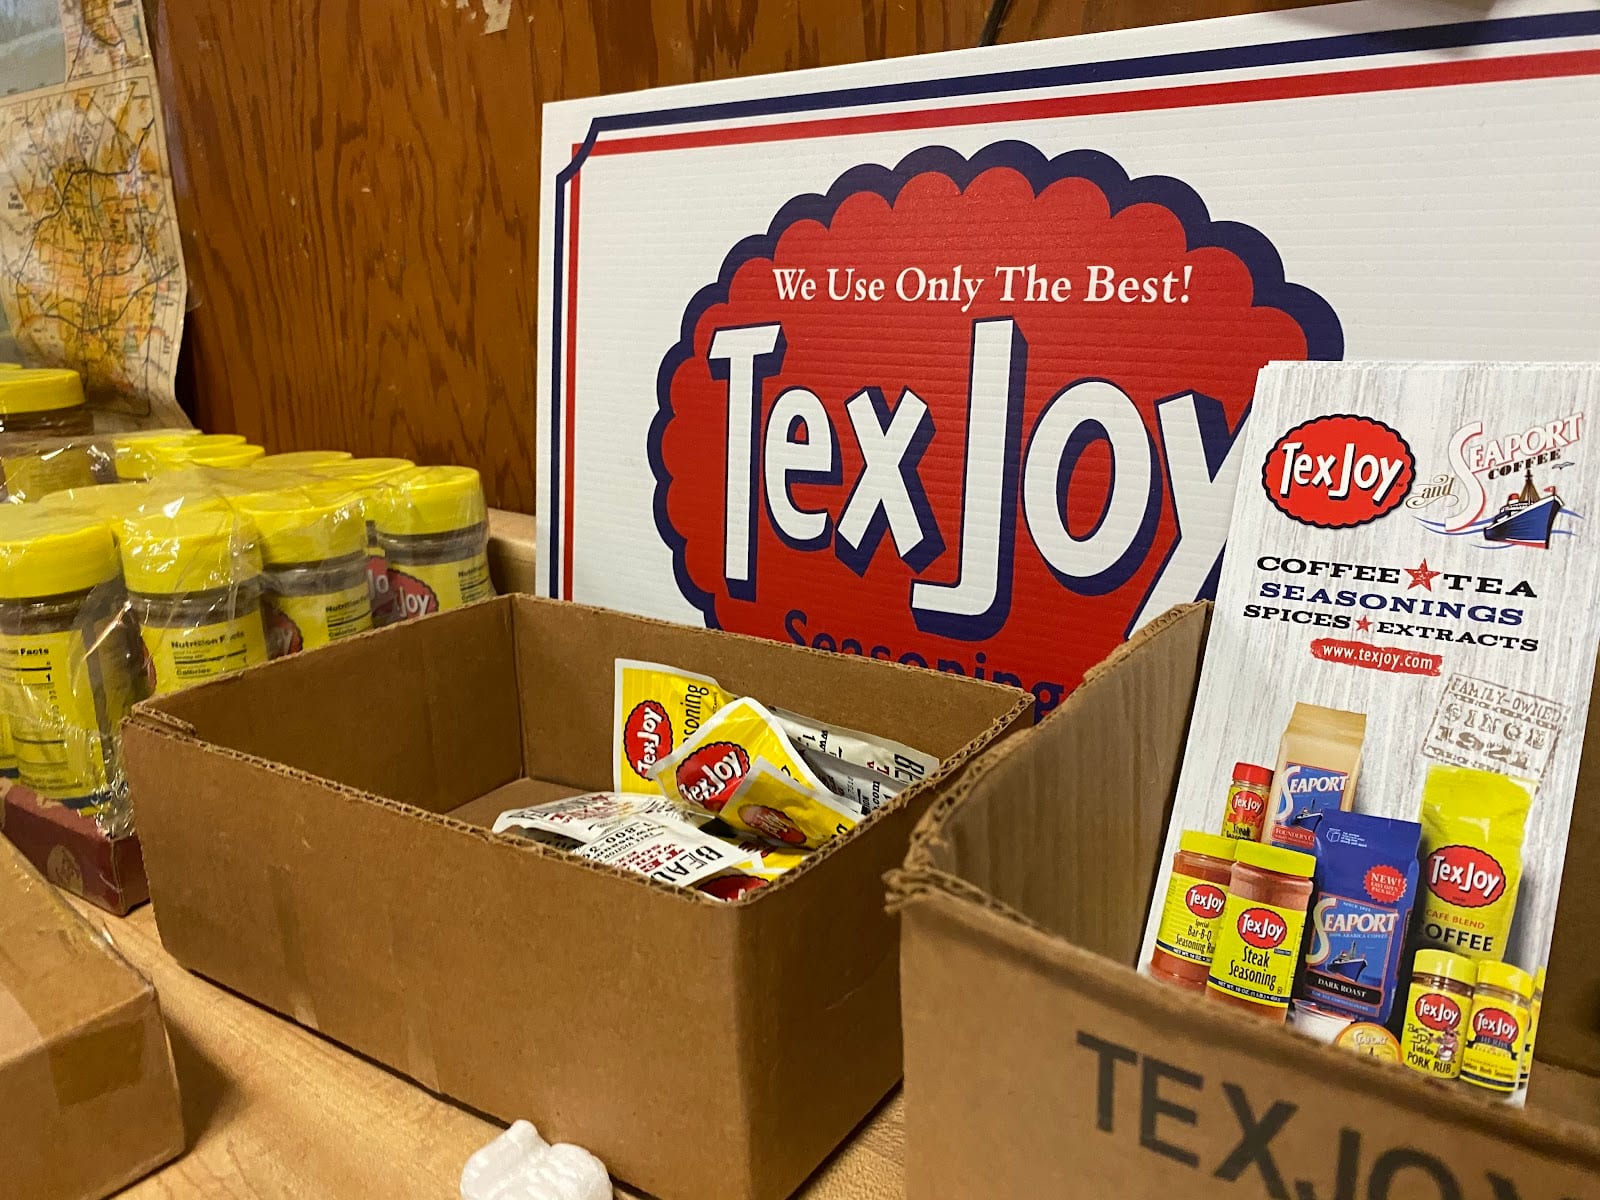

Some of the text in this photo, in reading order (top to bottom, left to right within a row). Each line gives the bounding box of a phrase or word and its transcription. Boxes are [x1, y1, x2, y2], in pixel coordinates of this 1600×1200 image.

[773, 264, 1193, 312] We Use Only The Best!
[708, 317, 1252, 641] TexJoy
[1280, 441, 1404, 506] TexJoy
[1445, 412, 1584, 533] SEAPORT
[1488, 449, 1561, 480] COFFEE
[1256, 555, 1538, 598] COFFEE TEA
[1259, 582, 1524, 625] SEASONINGS
[1243, 604, 1539, 651] SPICES EXTRACTS
[1322, 643, 1433, 671] www.texjoy.com
[636, 706, 664, 773] TexJoy
[1234, 795, 1262, 813] TexJoy
[1275, 765, 1349, 820] SEAPORT
[1371, 872, 1401, 886] NEW!
[1432, 855, 1500, 898] TexJoy
[1190, 889, 1224, 912] TexJoy
[1243, 913, 1284, 941] TexJoy
[1305, 898, 1399, 964] SEAPORT
[1426, 909, 1485, 930] CAFE BLEND
[1176, 934, 1207, 954] Seasoning
[1422, 922, 1493, 952] OFFEE
[1242, 946, 1270, 968] Steak
[1228, 960, 1277, 991] Seasoning
[1318, 978, 1367, 998] DARK ROAST
[1419, 998, 1458, 1025] TexJoy
[1477, 1013, 1517, 1039] TexJoy
[1408, 1051, 1430, 1070] PORK
[1433, 1061, 1451, 1074] RUB
[1077, 1030, 1519, 1200] TEXJO
